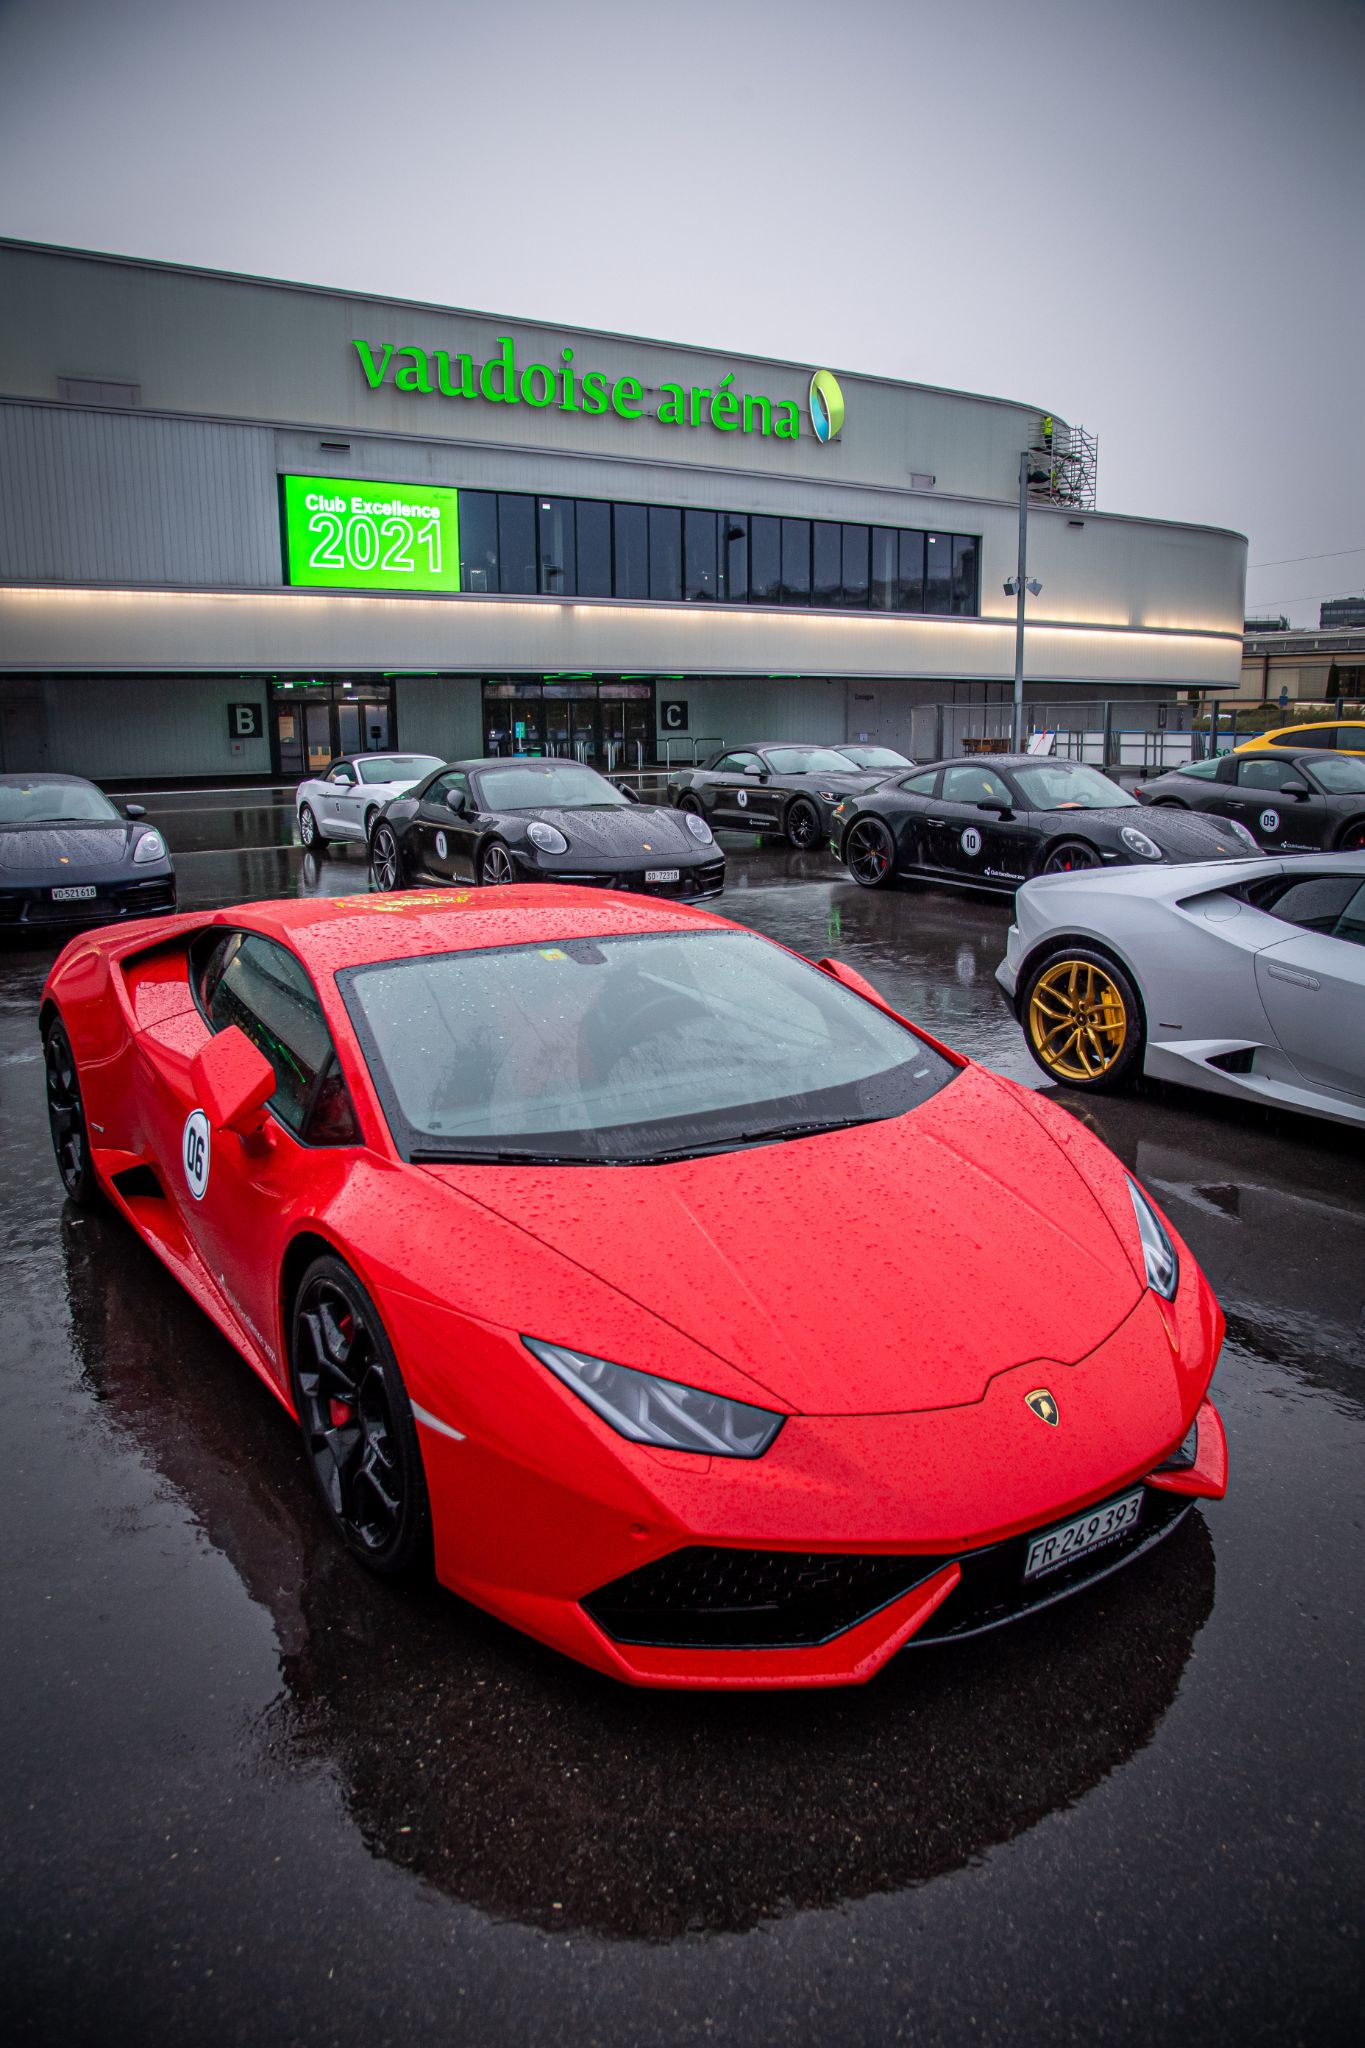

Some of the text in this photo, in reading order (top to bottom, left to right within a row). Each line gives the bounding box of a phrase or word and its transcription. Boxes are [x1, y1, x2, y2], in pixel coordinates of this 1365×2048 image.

[352, 336, 800, 441] vaudoise aréna
[305, 493, 441, 520] Club Excellence
[308, 512, 442, 573] 2021
[236, 707, 255, 734] B
[666, 704, 681, 727] C
[1263, 814, 1276, 827] 09
[966, 834, 976, 849] 10
[187, 1126, 205, 1182] 06
[1101, 1498, 1140, 1536] 393
